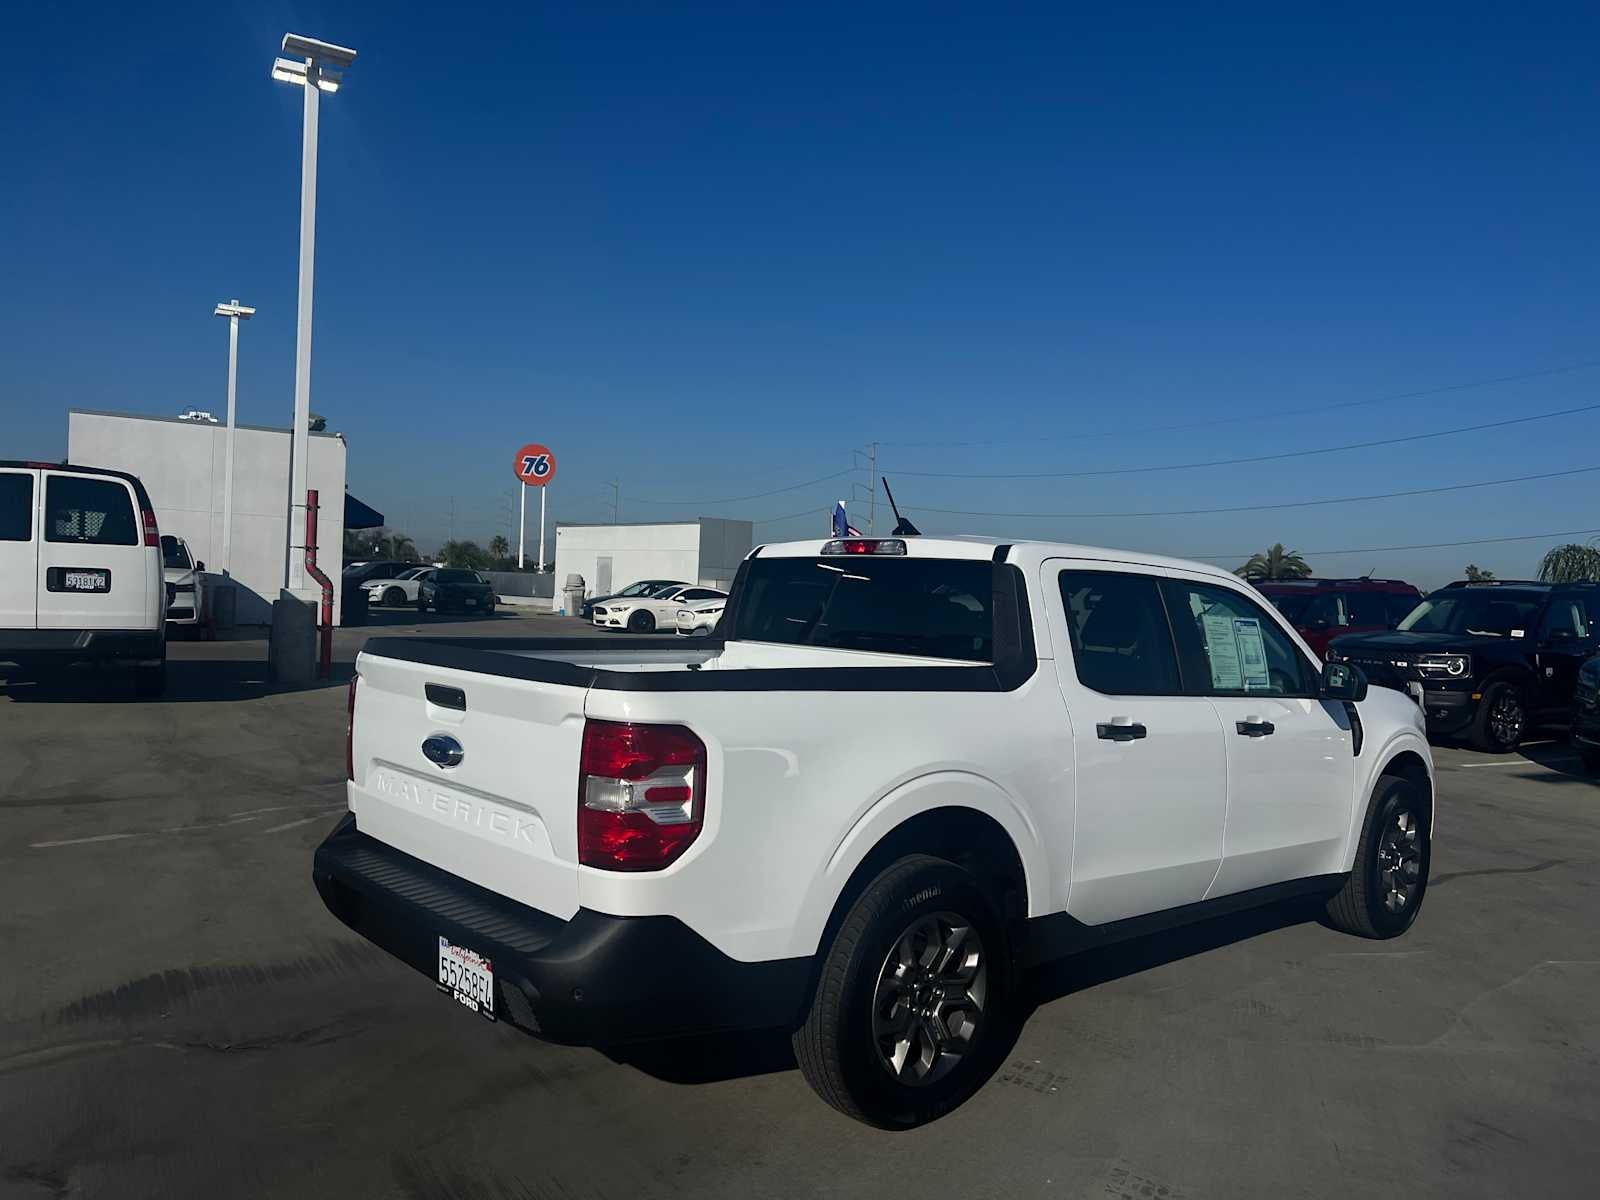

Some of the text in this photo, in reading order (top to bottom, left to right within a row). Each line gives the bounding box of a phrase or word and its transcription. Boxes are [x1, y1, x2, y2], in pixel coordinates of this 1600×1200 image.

[521, 454, 550, 477] 76
[376, 773, 537, 843] MAVERICK
[453, 989, 479, 1012] FORD
